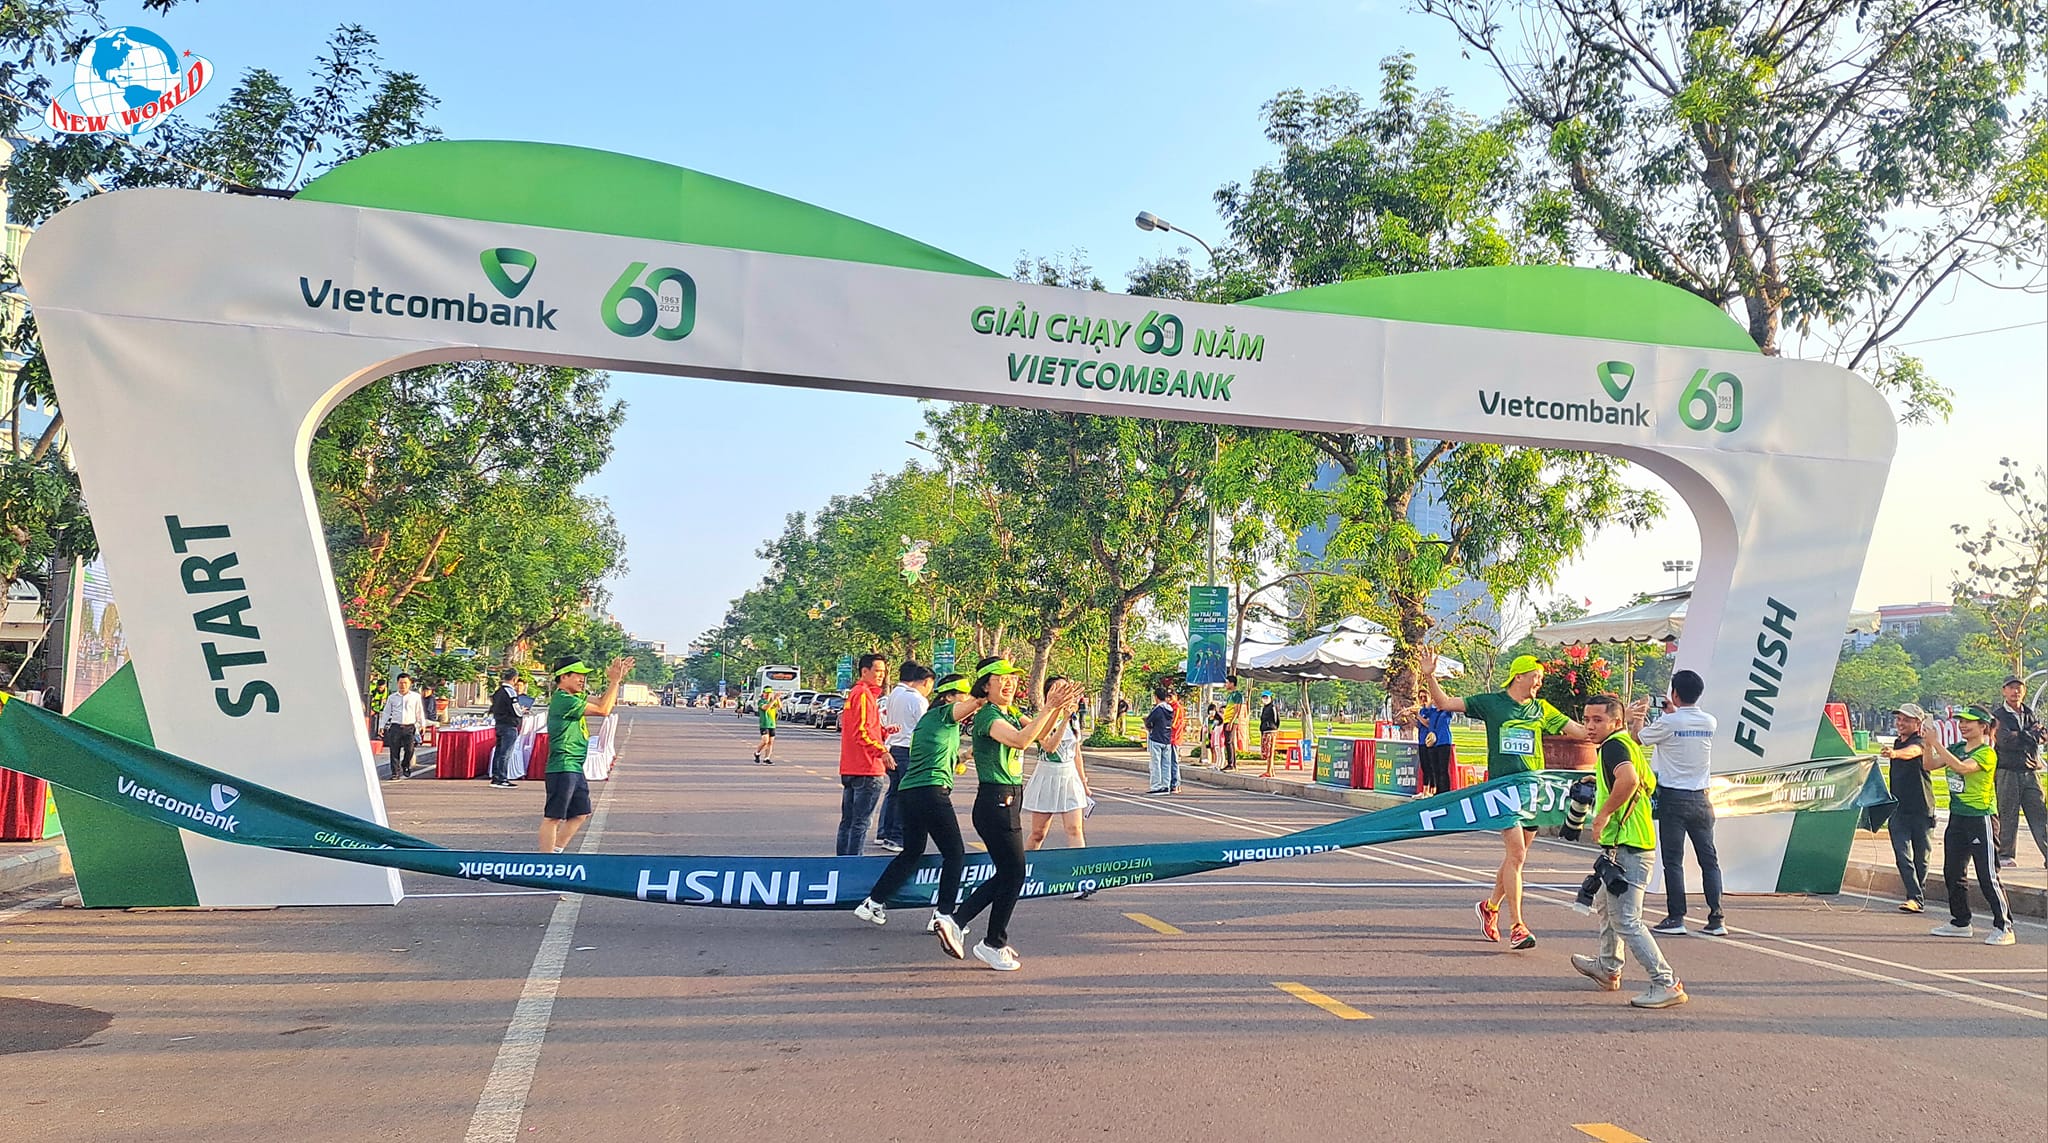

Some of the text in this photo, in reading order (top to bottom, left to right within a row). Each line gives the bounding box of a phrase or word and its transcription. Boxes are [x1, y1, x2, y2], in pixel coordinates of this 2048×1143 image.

[300, 276, 559, 331] Vietcombank
[601, 261, 697, 341] 60
[659, 305, 680, 313] 2023
[660, 296, 680, 304] 1963
[970, 301, 1265, 361] GIẢI CHẠY 60 NĂM
[1007, 352, 1236, 401] VIETCOMBANK
[1478, 389, 1651, 427] Vietcombank
[1678, 368, 1743, 433] 60
[164, 514, 281, 717] START
[1734, 596, 1798, 758] FINISH
[1504, 741, 1530, 751] 0119
[1808, 768, 1828, 782] TIM
[1819, 784, 1836, 799] TIN
[117, 775, 240, 833] Vietcombank
[458, 861, 586, 881] Vietcombank
[1071, 857, 1153, 877] VIETCOMBANK
[636, 870, 840, 905] FINISH
